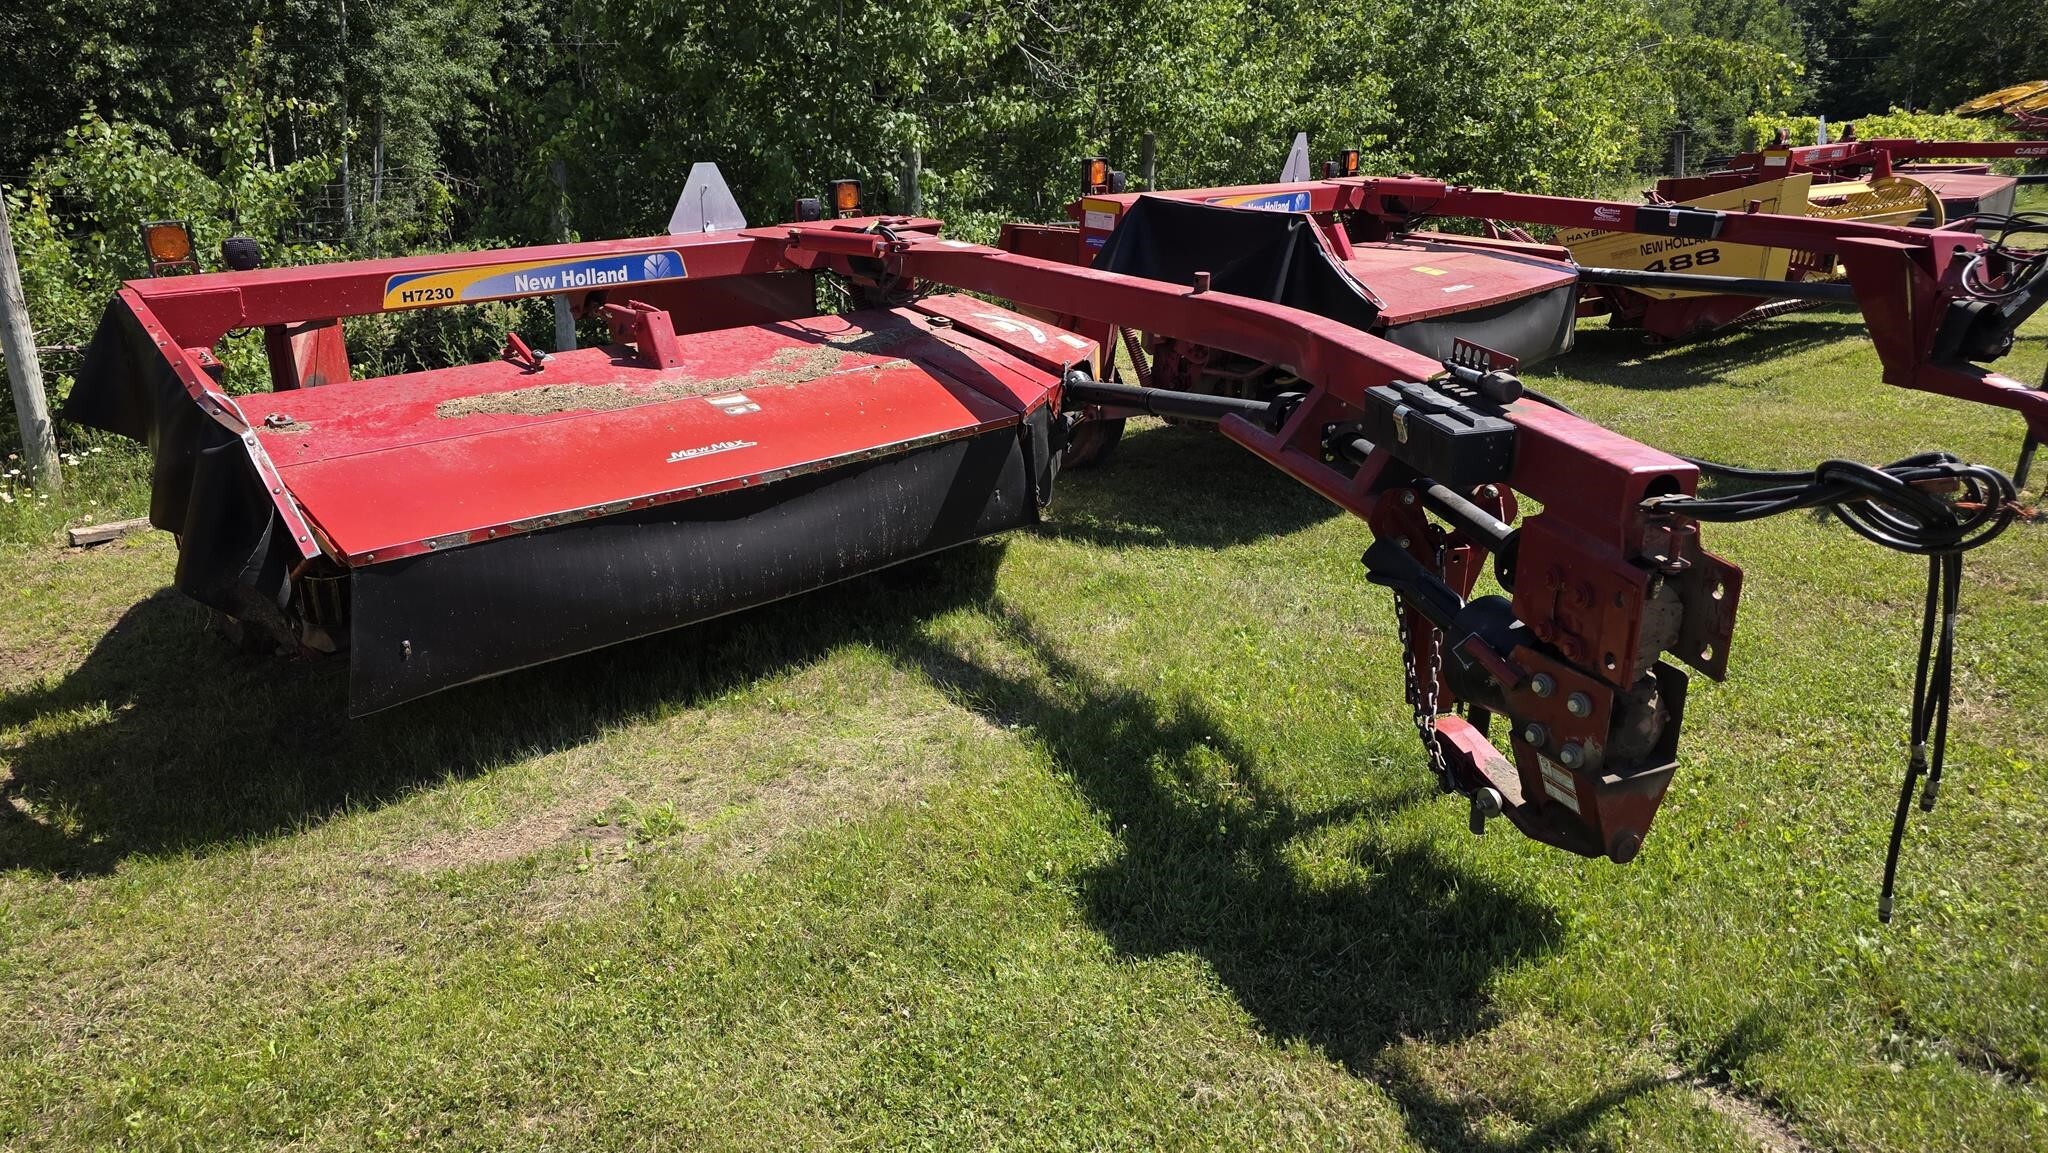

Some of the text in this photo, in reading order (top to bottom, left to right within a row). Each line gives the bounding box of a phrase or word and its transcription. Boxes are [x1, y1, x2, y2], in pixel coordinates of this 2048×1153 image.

[1640, 240, 1663, 256] NEW
[1644, 248, 1720, 273] 488
[514, 265, 629, 292] New Holland
[402, 287, 455, 303] H7230
